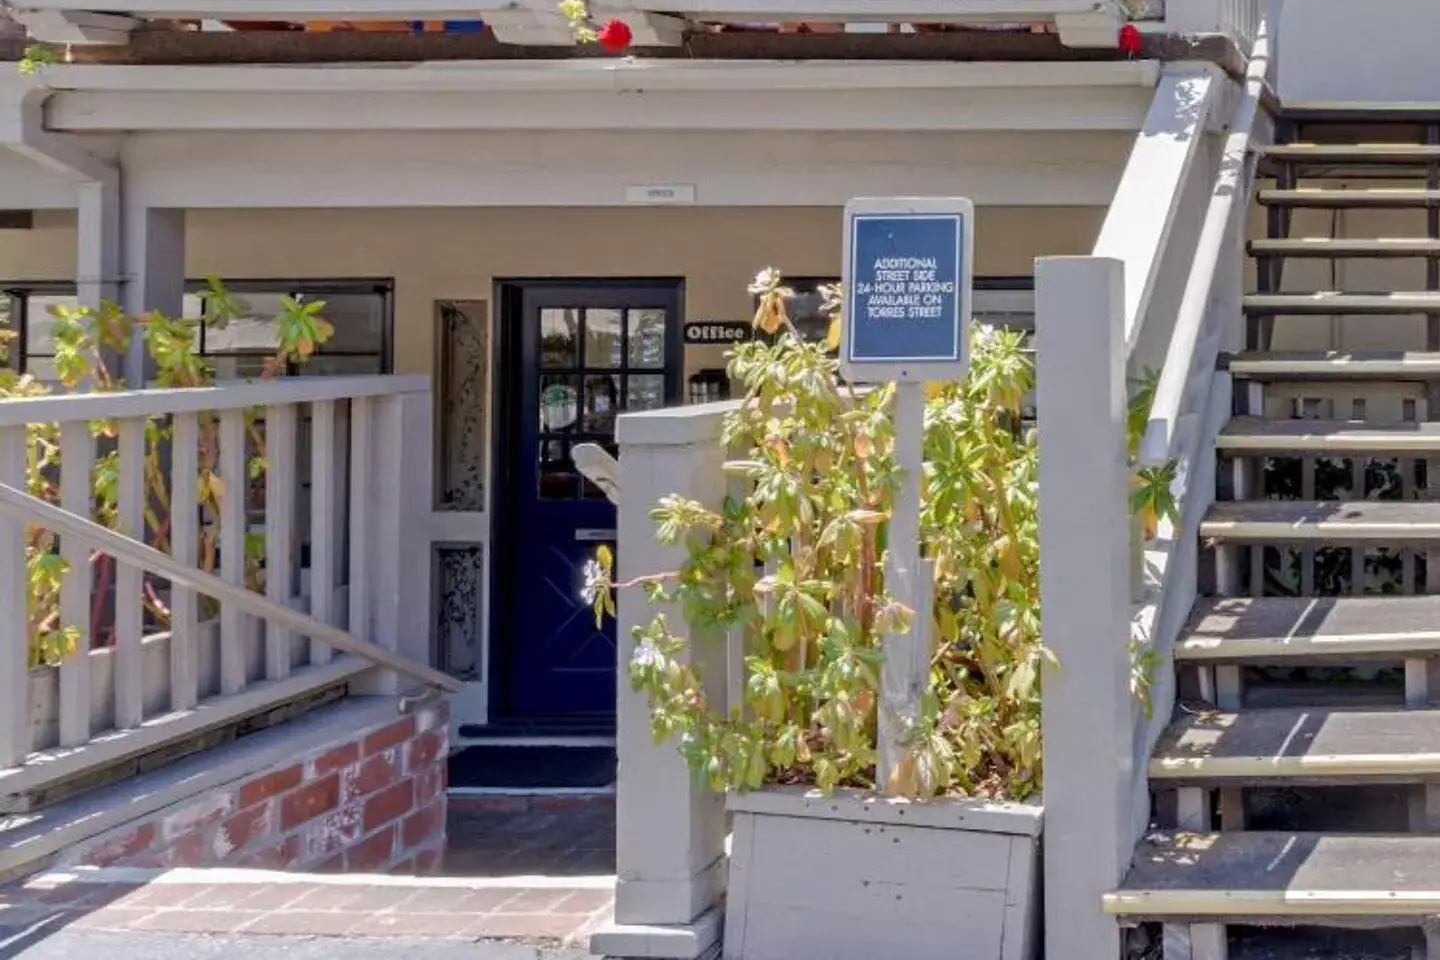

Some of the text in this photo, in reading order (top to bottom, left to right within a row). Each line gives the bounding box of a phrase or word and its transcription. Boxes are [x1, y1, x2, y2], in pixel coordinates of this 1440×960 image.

[874, 257, 938, 269] ADDITIONAL
[876, 270, 936, 281] STREET SIDE
[857, 282, 953, 294] 24-HOUR PARKING
[868, 294, 942, 306] AVAILABLE ON
[868, 306, 943, 318] TORRES STREET
[687, 326, 744, 339] Office
